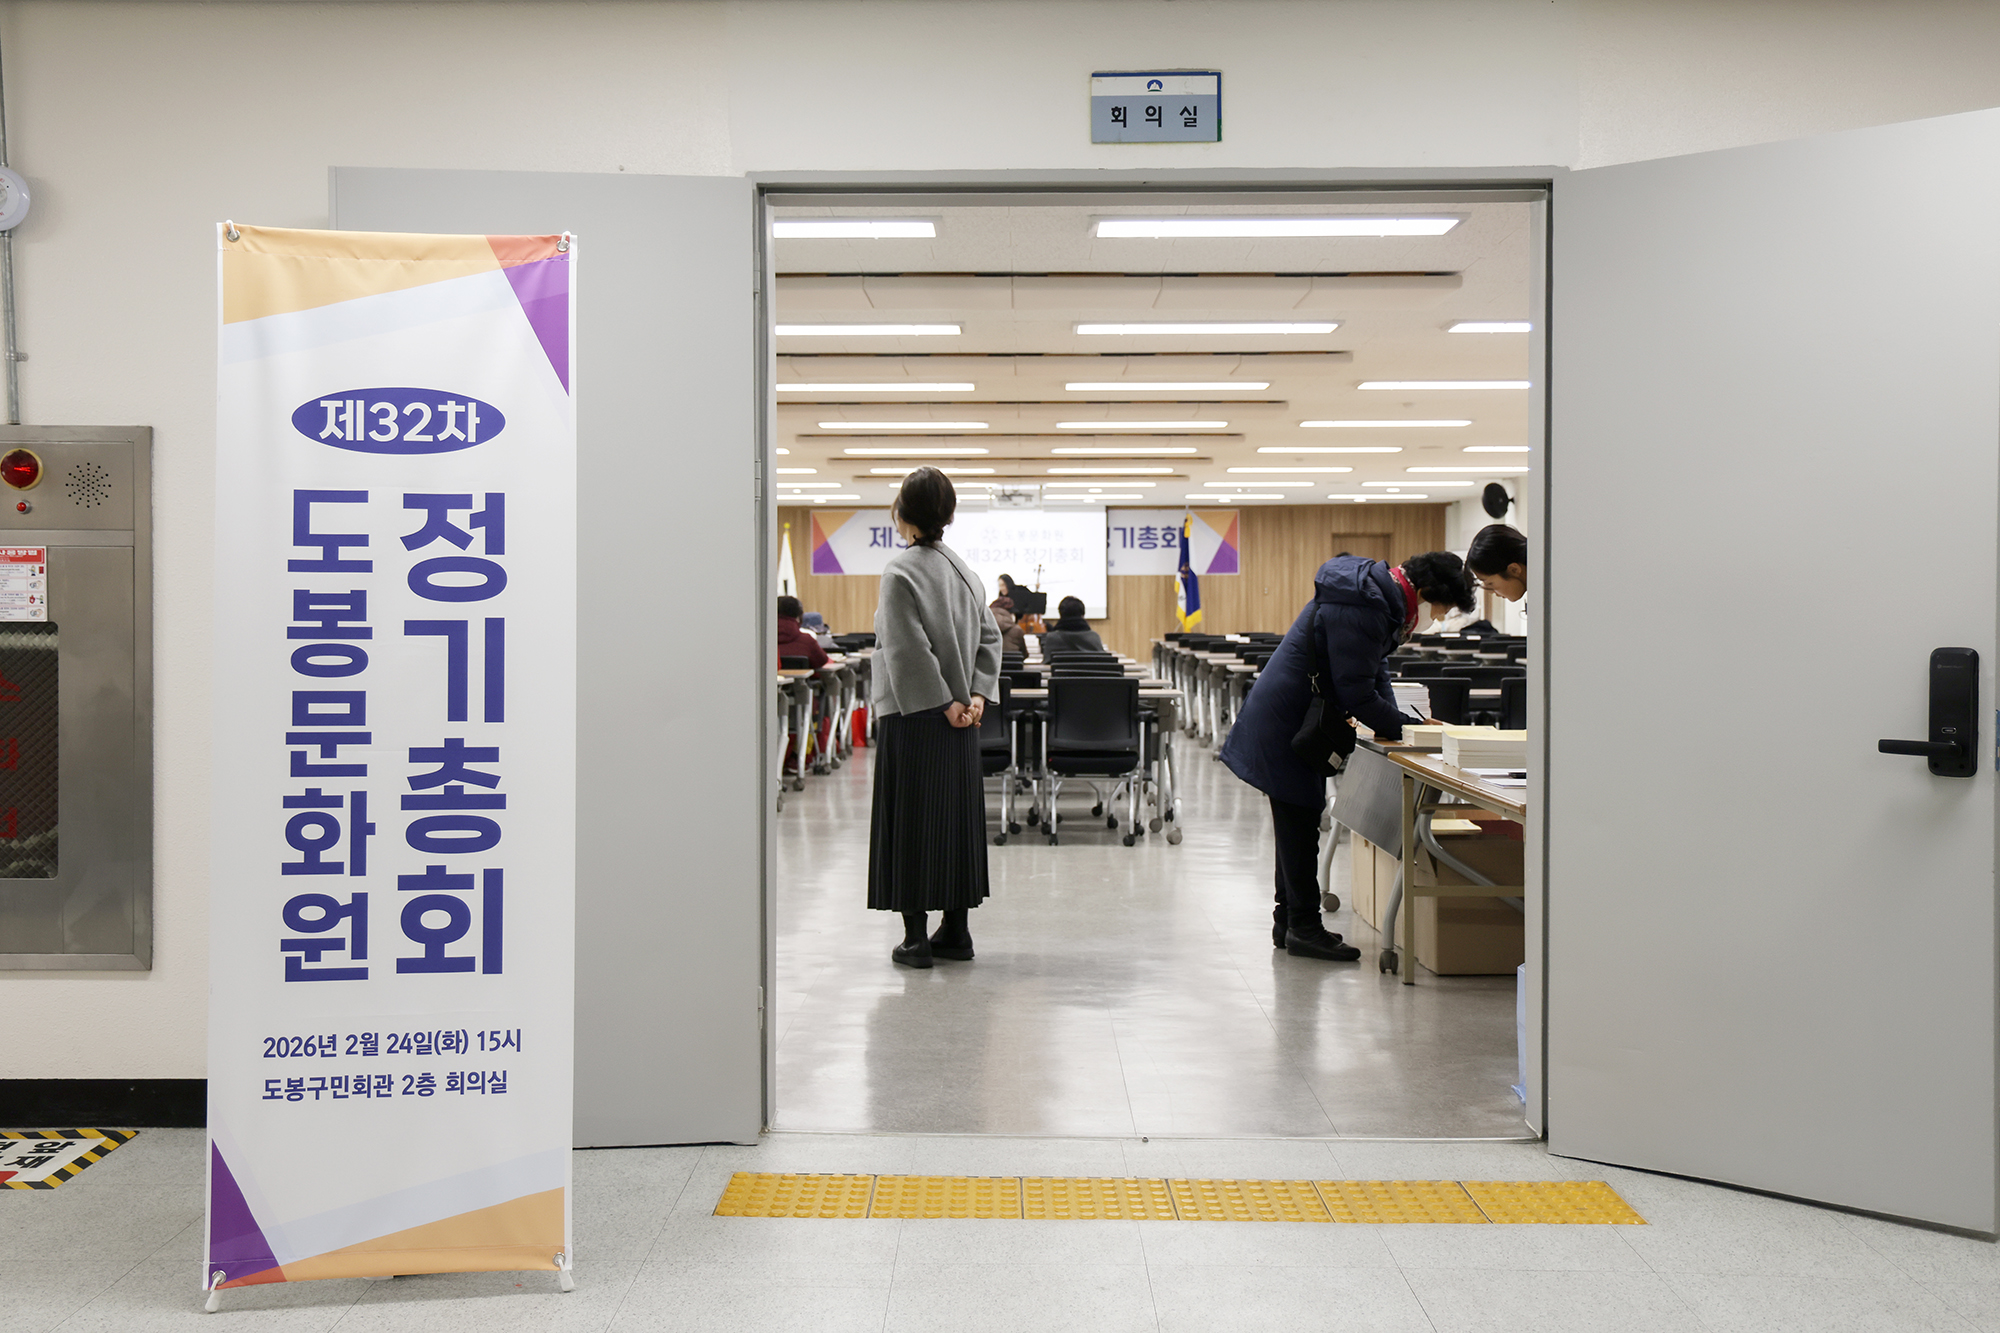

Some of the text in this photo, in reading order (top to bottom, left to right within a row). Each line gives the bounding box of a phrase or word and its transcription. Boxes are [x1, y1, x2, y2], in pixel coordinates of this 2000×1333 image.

[318, 399, 481, 443] 제32차
[1004, 529, 1064, 542] 도봉문화원
[965, 547, 1084, 564] 제32차 정기총회
[280, 489, 376, 983] 도봉문화원
[396, 492, 508, 975] 정기총회
[263, 1028, 522, 1058] 2026년 2월 24일(화) 15시
[262, 1070, 508, 1102] 도봉구민회관 2층 회의실
